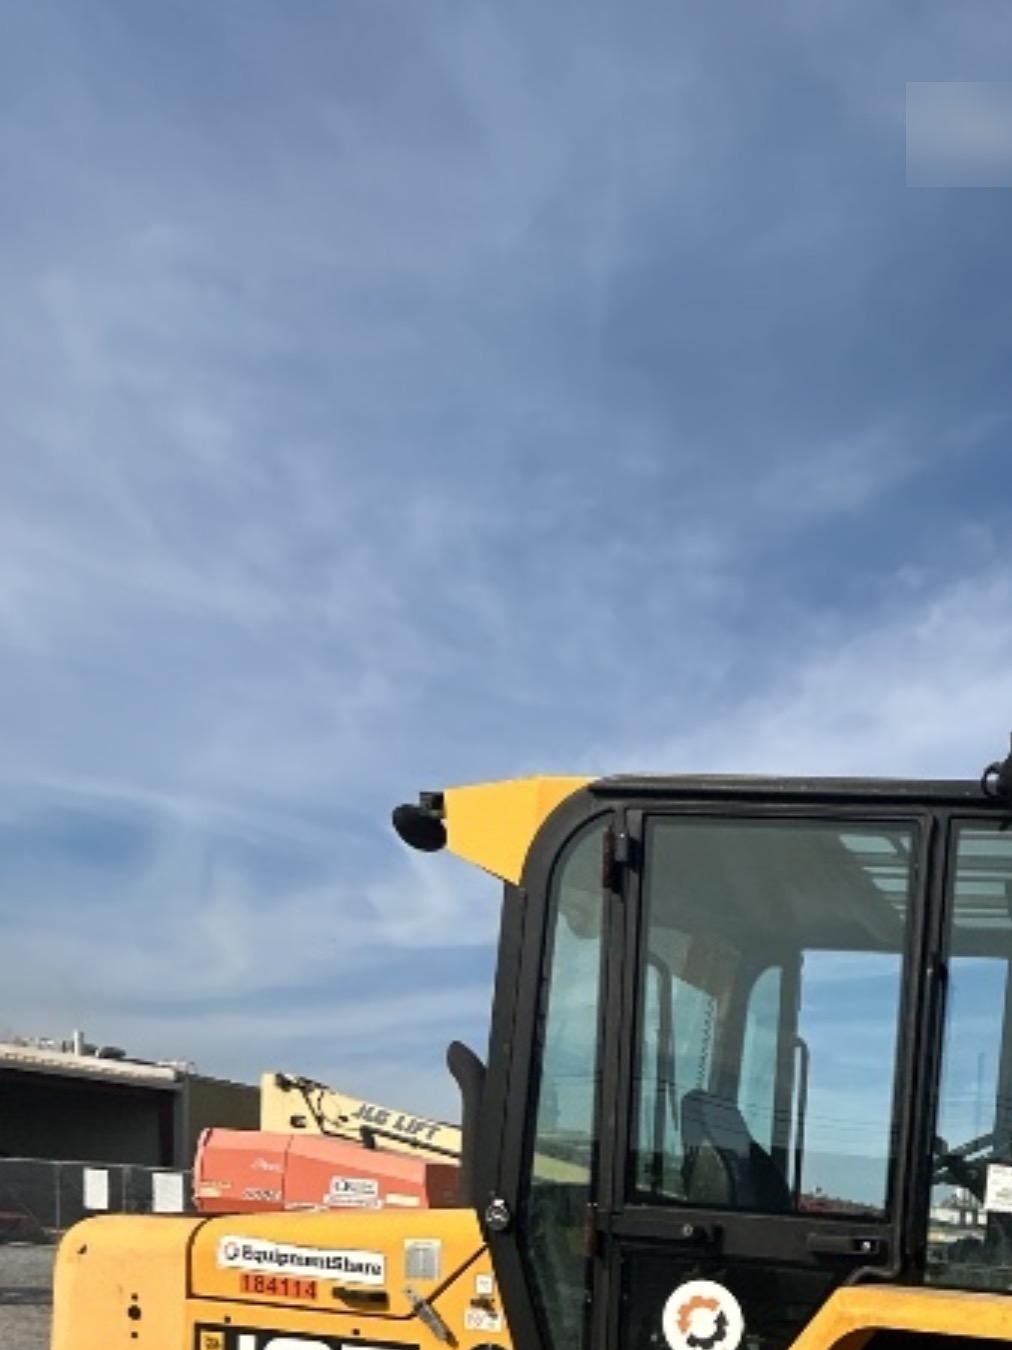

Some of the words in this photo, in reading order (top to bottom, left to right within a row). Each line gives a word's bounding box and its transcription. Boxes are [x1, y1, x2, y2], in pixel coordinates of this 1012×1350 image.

[392, 1115, 438, 1140] LIFT
[242, 1245, 381, 1275] EquipmentShare
[243, 1274, 316, 1299] 184114
